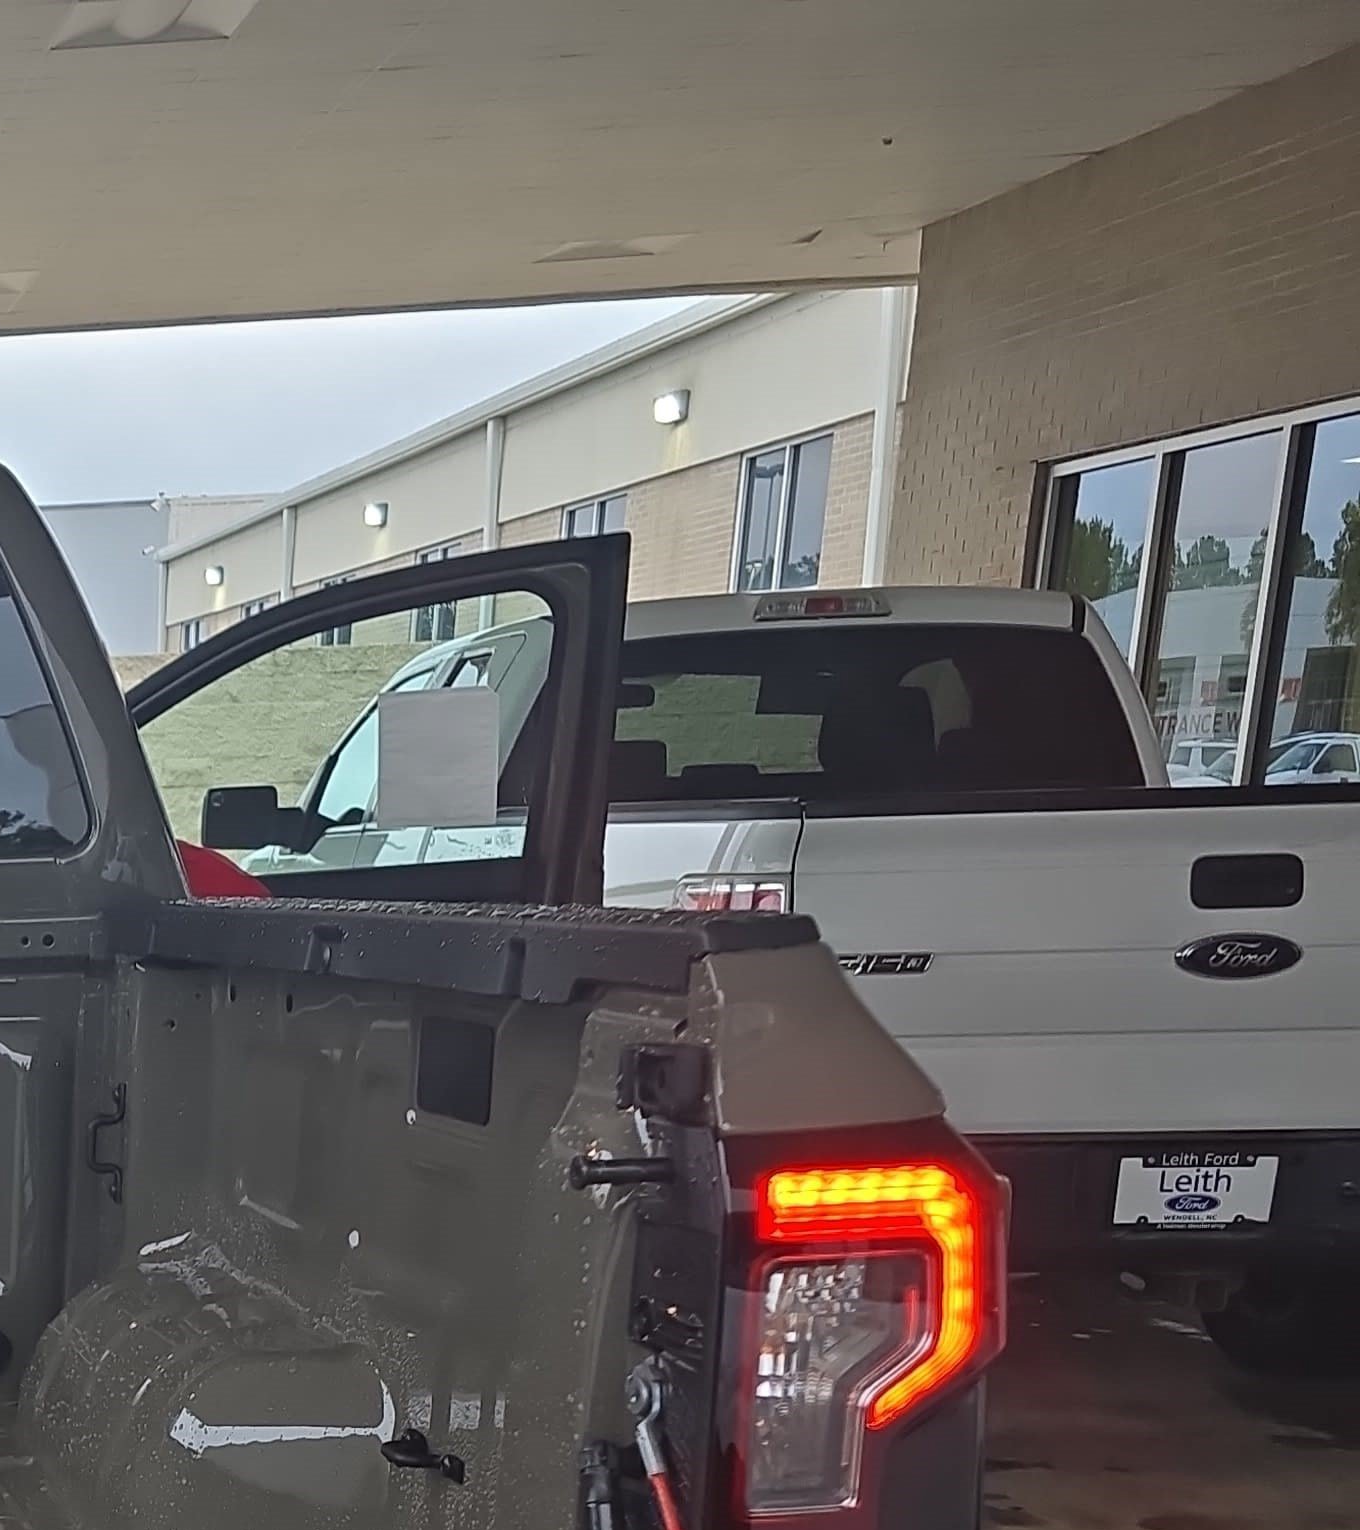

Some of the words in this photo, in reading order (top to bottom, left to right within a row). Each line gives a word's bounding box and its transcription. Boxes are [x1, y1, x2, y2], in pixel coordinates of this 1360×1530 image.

[1154, 711, 1223, 735] TRANCE
[1209, 941, 1277, 967] Ford
[1162, 1152, 1199, 1166] Leith
[1204, 1152, 1240, 1166] Ford
[1160, 1168, 1232, 1193] Leith
[1175, 1196, 1210, 1210] Ford
